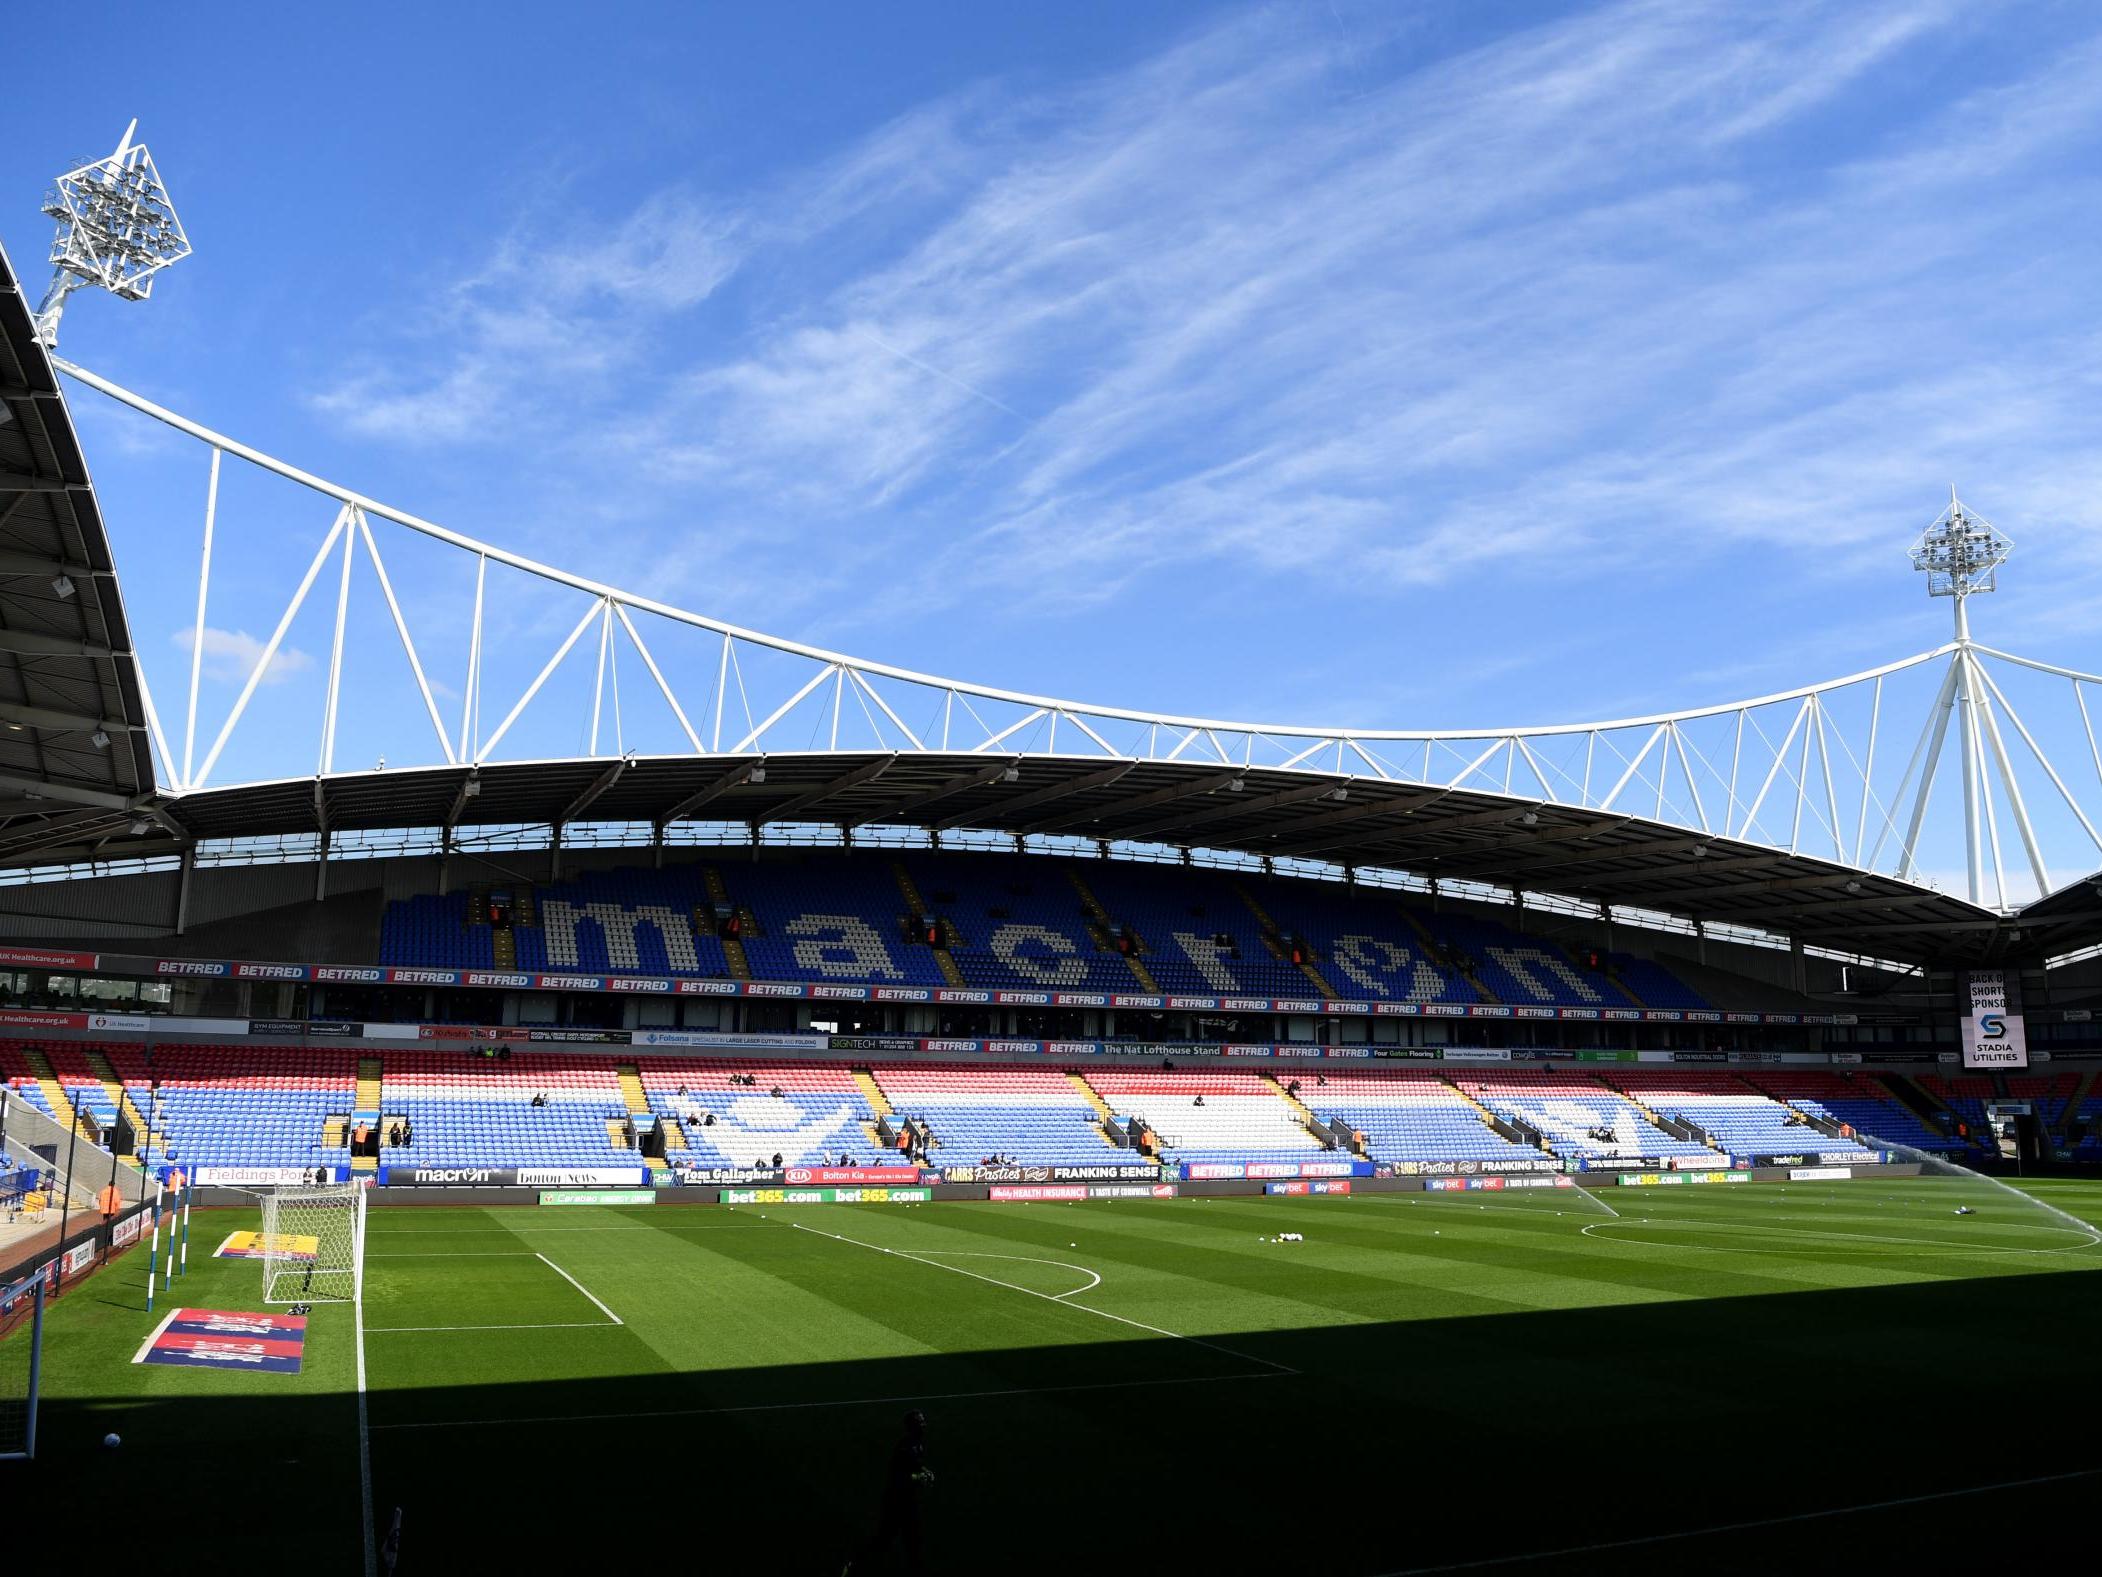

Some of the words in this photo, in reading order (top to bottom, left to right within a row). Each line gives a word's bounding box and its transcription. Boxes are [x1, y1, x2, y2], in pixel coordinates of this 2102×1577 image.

[157, 961, 224, 976] BETFRED
[238, 964, 303, 979] BETFRED
[317, 968, 380, 982] BETFRED
[393, 971, 455, 985] BETFRED
[1968, 974, 1994, 984] BACK
[468, 974, 528, 988] BETFRED
[540, 977, 600, 990] BETFRED
[612, 979, 669, 992] BETFRED
[681, 982, 736, 995] BETFRED
[748, 984, 802, 997] BETFRED
[813, 987, 866, 999] BETFRED
[1971, 986, 2008, 996] SHORTS
[876, 989, 928, 1001] BETFRED
[939, 990, 989, 1002] BETFRED
[999, 992, 1048, 1004] BETFRED
[1058, 994, 1105, 1005] BETFRED
[1114, 996, 1161, 1007] BETFRED
[1170, 998, 1215, 1009] BETFRED
[1224, 999, 1268, 1010] BETFRED
[1276, 1001, 1319, 1011] BETFRED
[1968, 998, 2012, 1009] SPONSOR
[1327, 1003, 1368, 1013] BETFRED
[1377, 1004, 1417, 1014] BETFRED
[1425, 1005, 1464, 1015] BETFRED
[1472, 1007, 1510, 1016] BETFRED
[1517, 1008, 1554, 1017] BETFRED
[1561, 1009, 1597, 1018] BETFRED
[1605, 1010, 1639, 1019] BETFRED
[1646, 1011, 1680, 1020] BETFRED
[1687, 1012, 1720, 1021] BETFRED
[1727, 1013, 1759, 1022] BETFRED
[1765, 1014, 1797, 1023] BETFRED
[1802, 1015, 1832, 1024] BETFRED
[659, 1034, 690, 1043] Folsana
[832, 1039, 876, 1049] SIGNTECH
[927, 1041, 977, 1052] BETFRED
[988, 1042, 1037, 1053] BETFRED
[1049, 1043, 1096, 1054] BETFRED
[1104, 1044, 1122, 1054] The
[1124, 1046, 1141, 1055] Nat
[1143, 1045, 1191, 1055] Lofthouse
[1193, 1046, 1220, 1056] Stand
[1227, 1047, 1270, 1057] BETFRED
[1977, 1044, 2013, 1052] STADIA
[1278, 1048, 1320, 1057] BETFRED
[1328, 1048, 1369, 1058] BETFRED
[1374, 1050, 1388, 1058] Four
[1409, 1050, 1434, 1059] Flooring
[1973, 1053, 2018, 1062] UTILITIES
[1772, 1156, 1803, 1165] tradefred
[1821, 1152, 1852, 1161] CHORLEY
[1852, 1151, 1879, 1160] Electrical
[1191, 1165, 1244, 1177] BETFRED
[1247, 1164, 1299, 1176] BETFRED
[1301, 1163, 1352, 1175] BETFRED
[1394, 1161, 1418, 1175] CARRS
[1418, 1161, 1455, 1175] Pasties
[1481, 1160, 1533, 1171] FRANKING
[1534, 1160, 1564, 1170] SENSE
[207, 1168, 276, 1183] Fieldings
[415, 1168, 489, 1183] macron
[684, 1168, 711, 1180] Tom
[713, 1168, 775, 1184] Gallagher
[789, 1171, 808, 1181] KIA
[822, 1172, 849, 1180] Bolton
[851, 1172, 865, 1180] Kia
[944, 1167, 974, 1183] CARRS
[974, 1167, 1021, 1182] Pasties
[1053, 1166, 1118, 1179] FRANKING
[1119, 1166, 1158, 1178] SENSE
[1690, 1172, 1749, 1184] bet365.com
[1432, 1180, 1445, 1190] sky
[1446, 1179, 1460, 1188] bet
[1471, 1179, 1483, 1189] sky
[1484, 1178, 1497, 1187] bet
[1623, 1174, 1683, 1186] bet365.com
[1013, 1187, 1042, 1199] HEALTH
[1043, 1187, 1086, 1198] INSURANCE
[1090, 1187, 1095, 1197] A
[1096, 1187, 1111, 1197] TASTE
[1112, 1187, 1120, 1197] OF
[1120, 1187, 1150, 1197] CORNWALL
[1272, 1184, 1287, 1194] sky
[1287, 1183, 1303, 1193] bet
[1314, 1183, 1328, 1193] sky
[1329, 1182, 1344, 1191] bet
[728, 1190, 822, 1204] bet365.com
[835, 1189, 925, 1203] bet365.com
